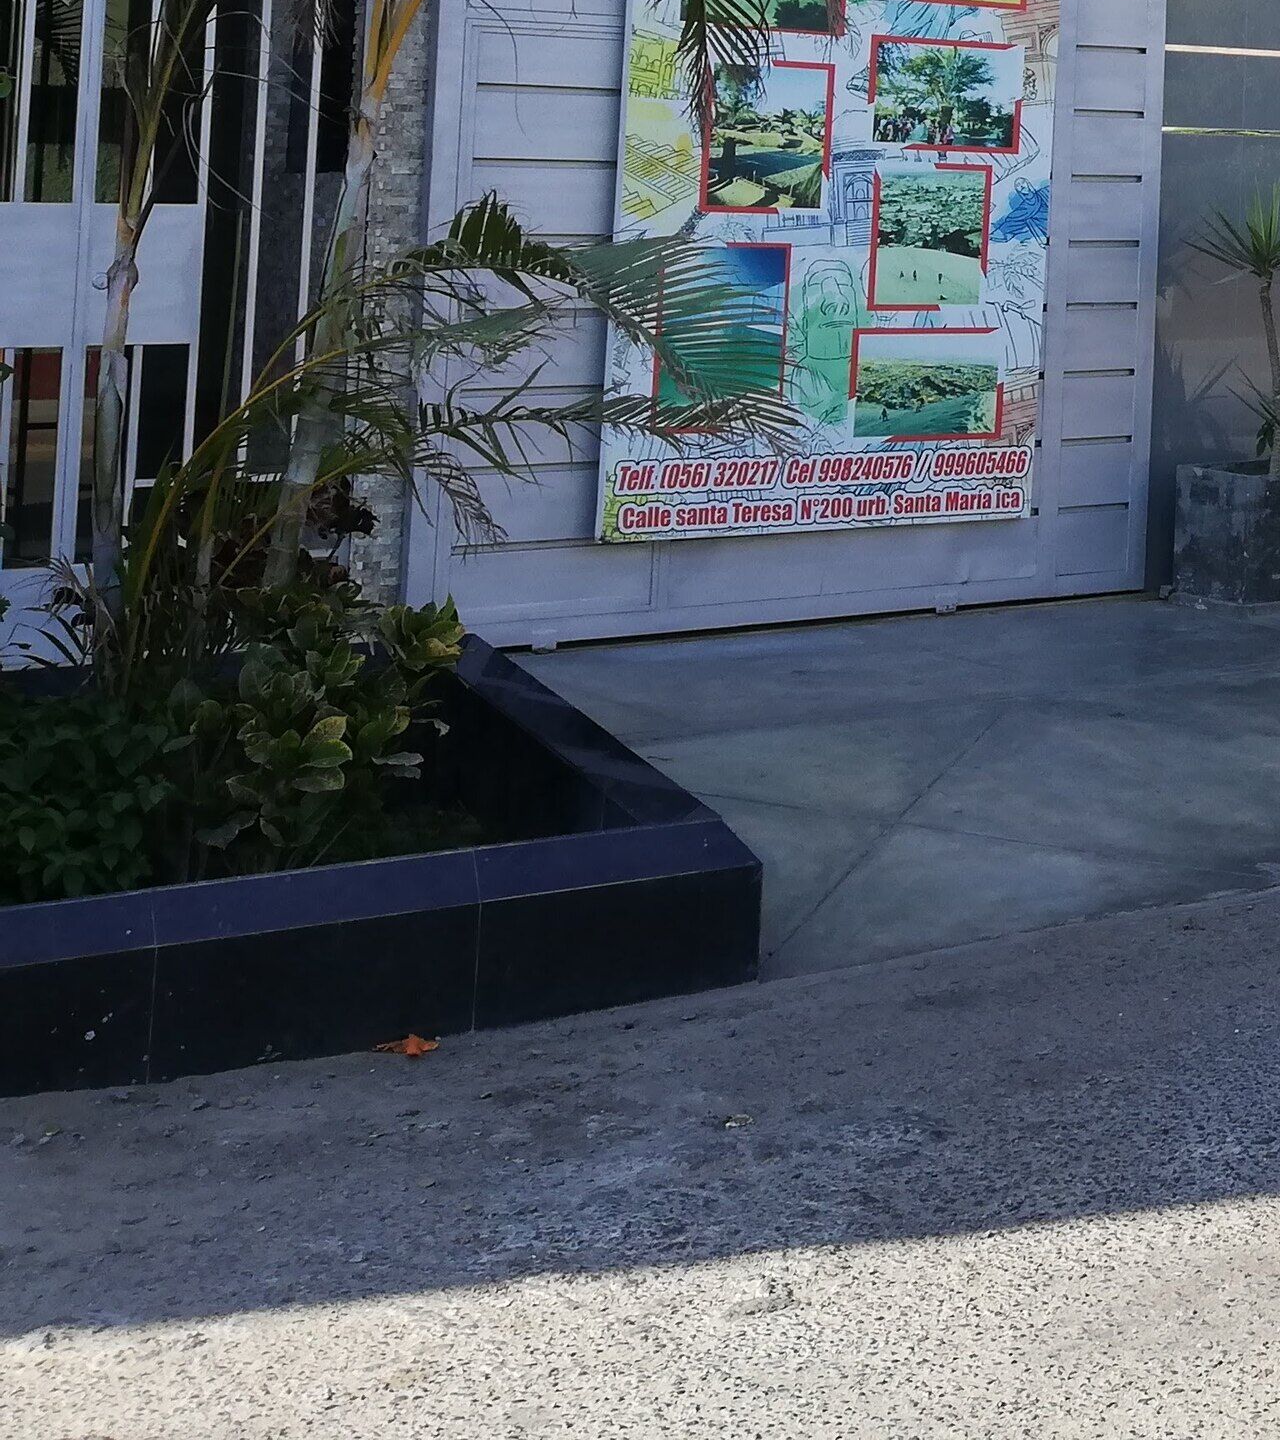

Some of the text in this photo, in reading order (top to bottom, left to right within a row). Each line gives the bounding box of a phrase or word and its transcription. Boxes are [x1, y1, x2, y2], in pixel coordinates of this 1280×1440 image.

[618, 465, 656, 491] Telf.
[660, 463, 711, 489] (056)
[713, 460, 778, 487] 320217
[786, 460, 815, 484] Cel
[818, 454, 914, 481] 998240576
[933, 451, 1028, 477] 999605466
[622, 506, 671, 529] Calle
[676, 506, 728, 526] santa
[732, 502, 793, 523] Teresa
[857, 496, 889, 517] urb.
[894, 491, 941, 514] Santa
[945, 487, 992, 510] María
[995, 488, 1020, 508] ica
